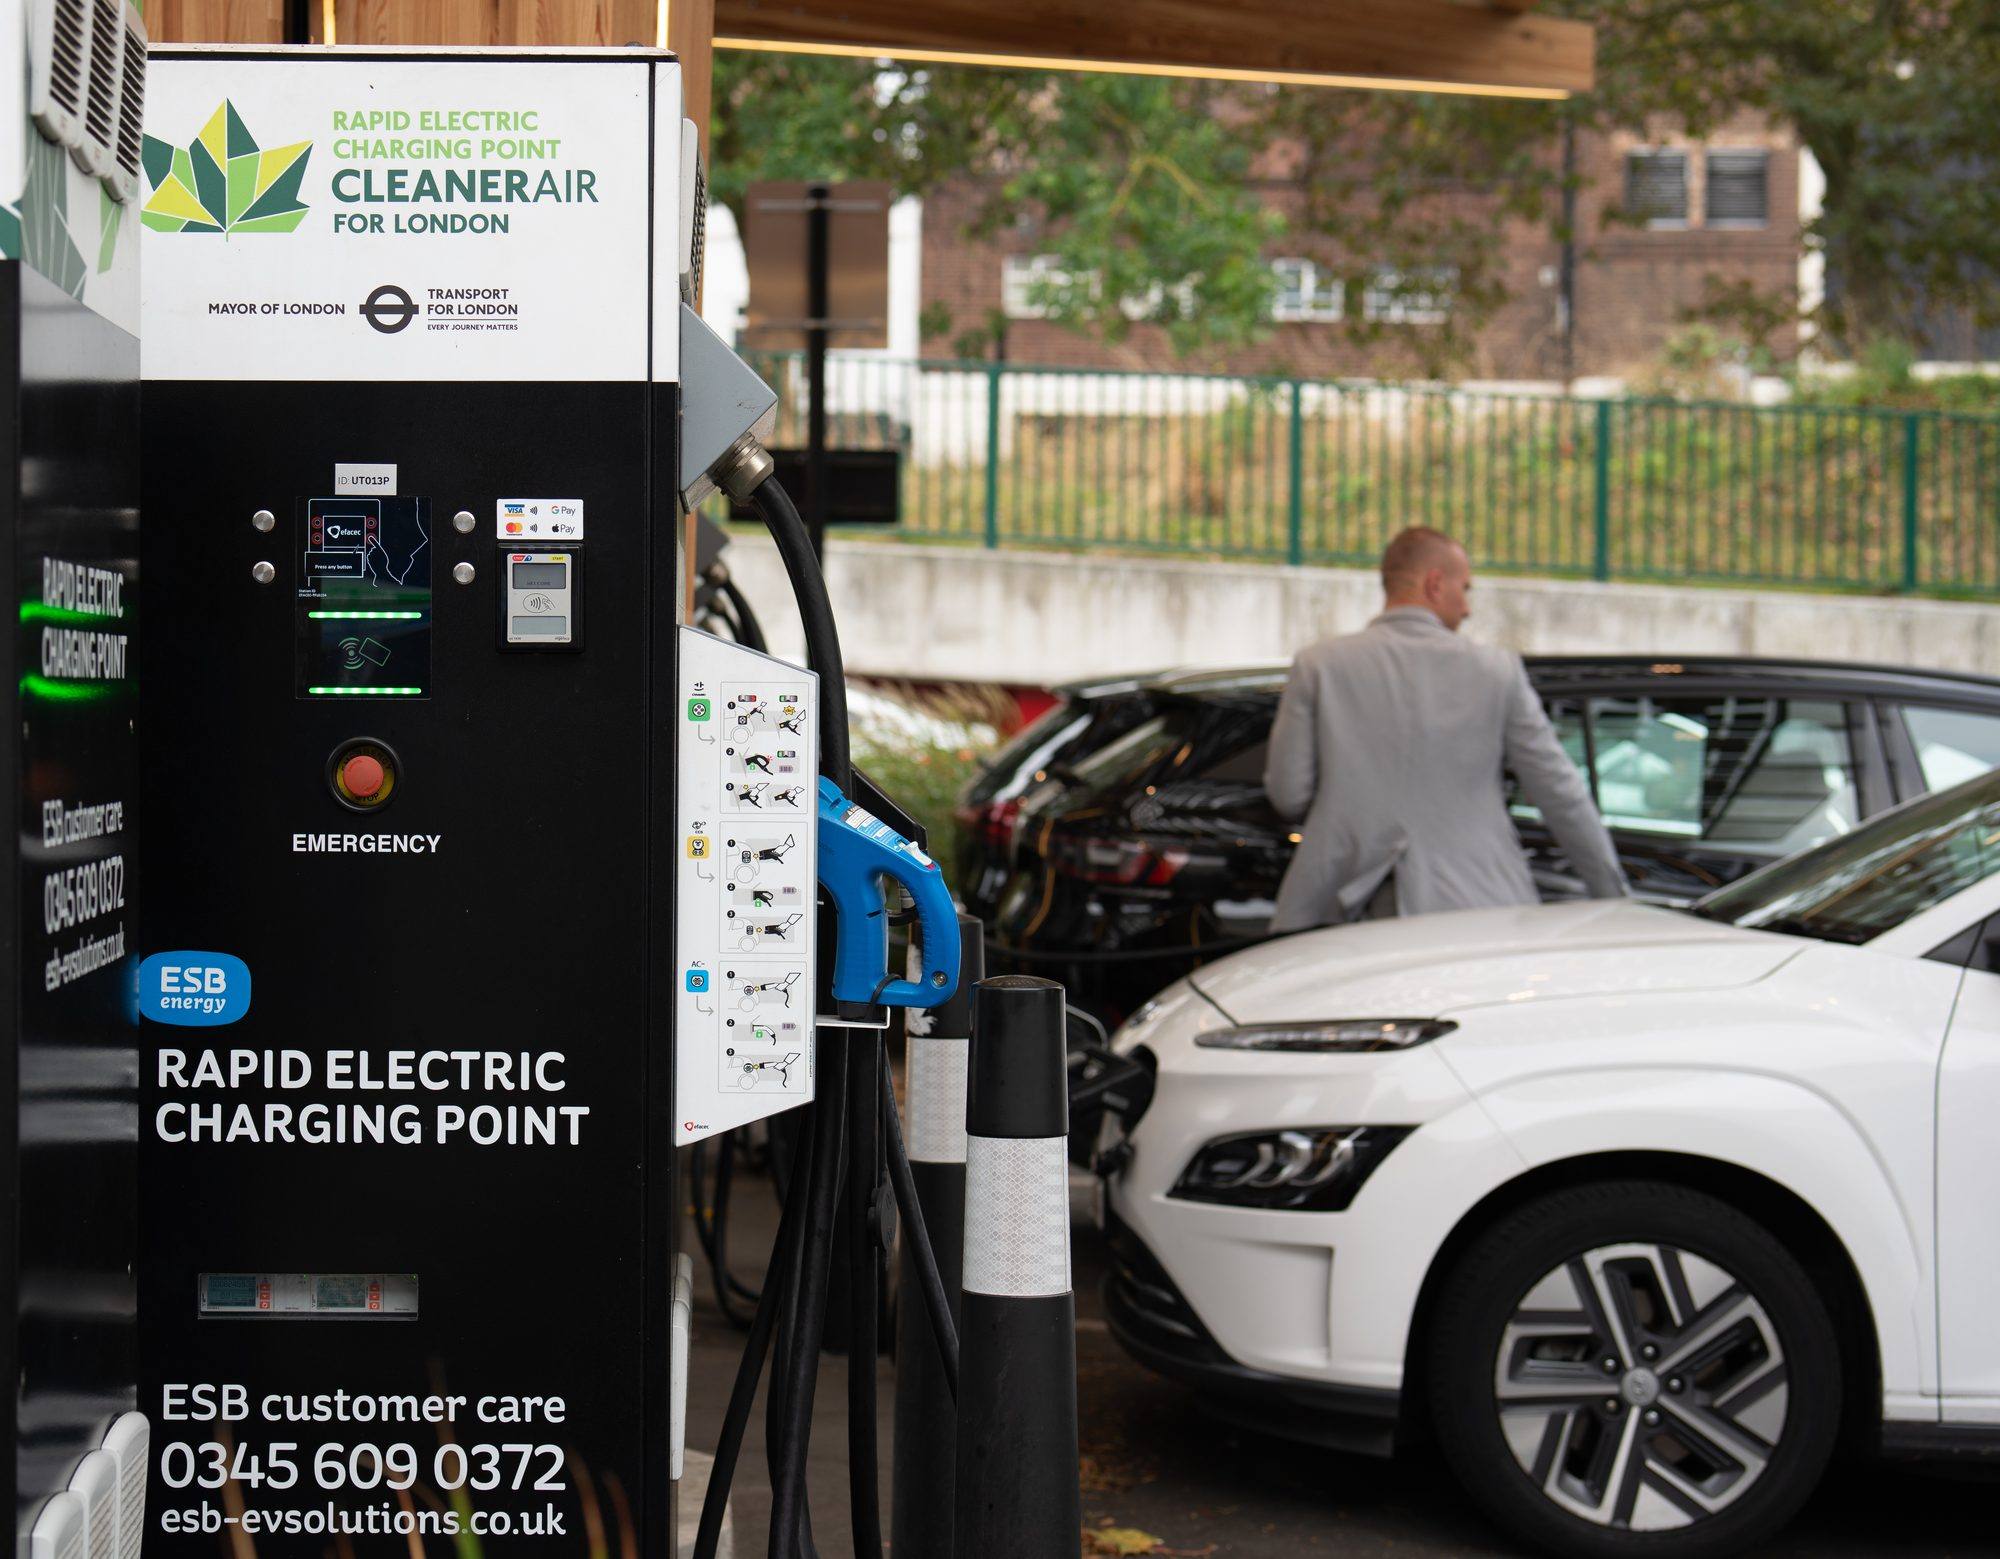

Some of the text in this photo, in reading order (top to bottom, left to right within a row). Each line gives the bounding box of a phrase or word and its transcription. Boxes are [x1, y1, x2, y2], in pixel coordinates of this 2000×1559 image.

[333, 111, 538, 131] RAPID ELECTRIC
[333, 139, 561, 159] CHARGING POINT
[334, 213, 509, 234] FOR LONDON
[427, 289, 509, 299] TRANSPORT
[209, 303, 345, 315] MAYOR OF LONDON
[427, 304, 518, 315] FOR LONDON
[351, 477, 390, 485] UT013P
[561, 506, 576, 516] Pay
[340, 528, 361, 536] efacec
[560, 524, 575, 534] Pay
[43, 557, 124, 618] RAPID ELECTRIC
[42, 626, 128, 679] CHARGING POINT
[43, 799, 63, 848] ESB
[105, 801, 123, 835] care
[292, 833, 442, 854] EMERGENCY
[76, 862, 98, 924] 609
[99, 855, 125, 915] 0372
[160, 966, 227, 994] ESB
[160, 997, 226, 1014] energy
[158, 1049, 566, 1091] RAPID ELECTRIC
[156, 1103, 590, 1146] CHARGING POINT
[163, 1384, 566, 1423] ESB customer care
[161, 1442, 566, 1491] 0345 609 0372
[161, 1501, 567, 1535] esb-evsolutions.co.uk
